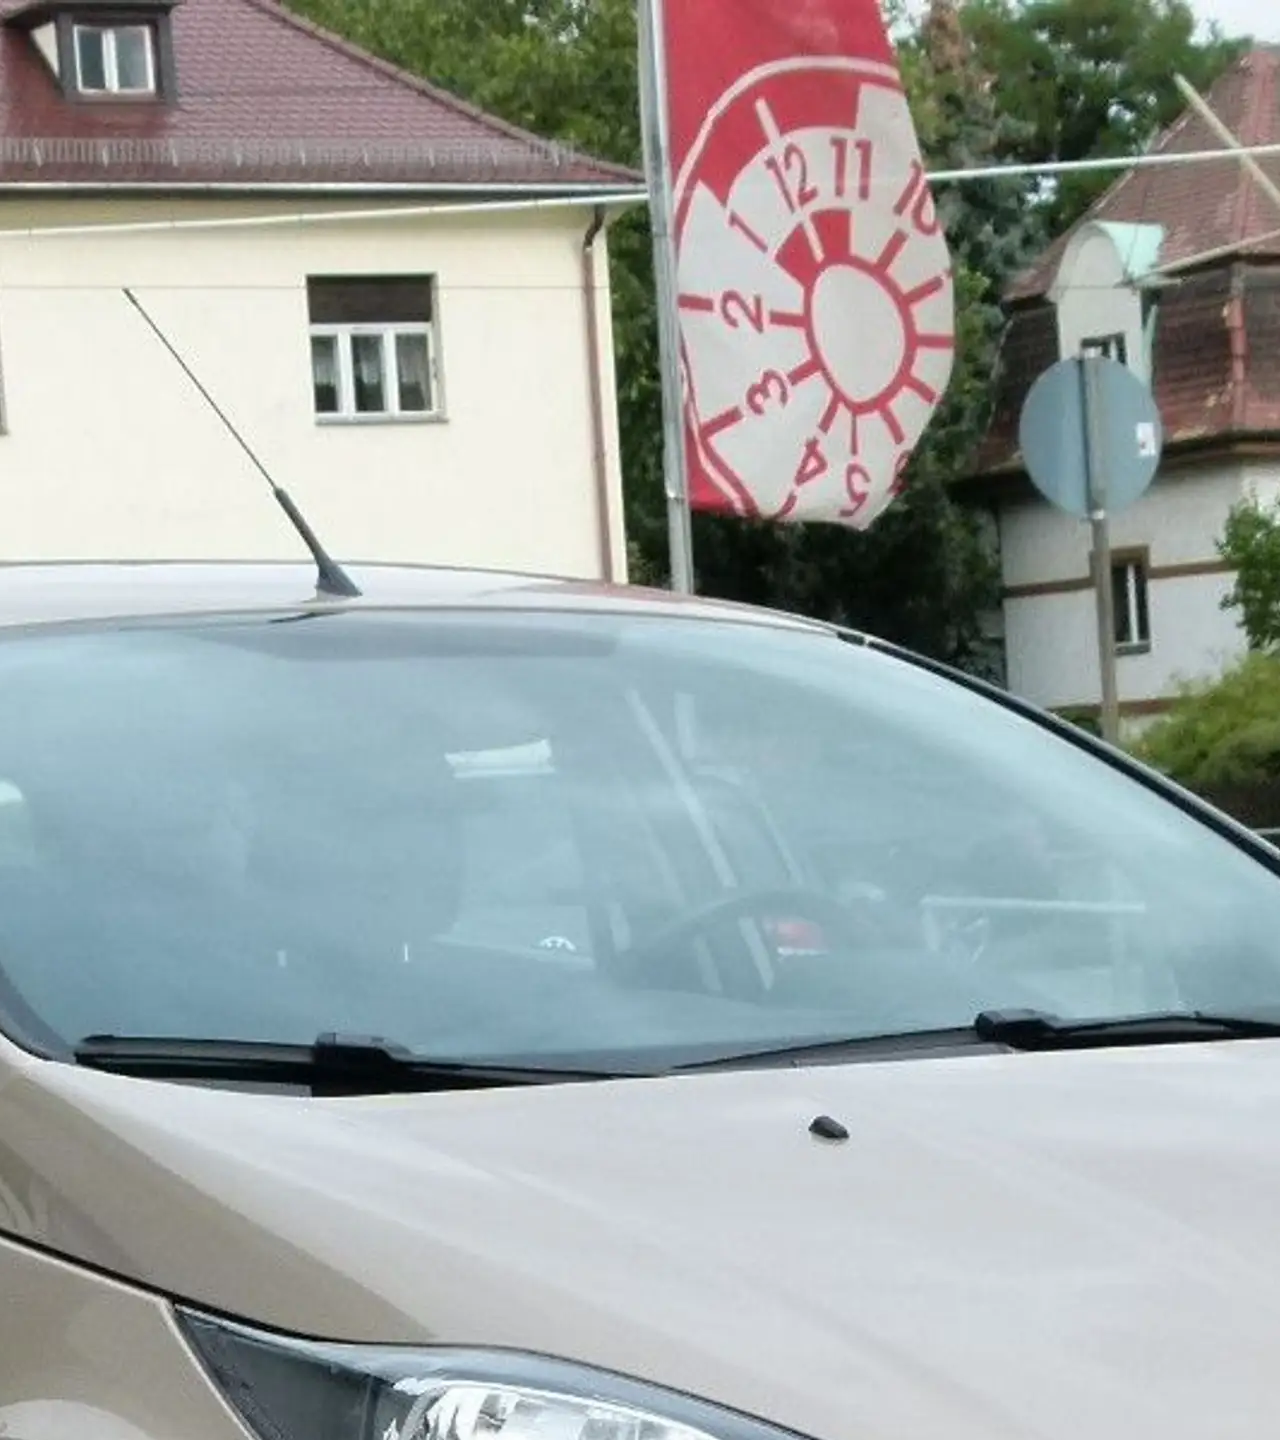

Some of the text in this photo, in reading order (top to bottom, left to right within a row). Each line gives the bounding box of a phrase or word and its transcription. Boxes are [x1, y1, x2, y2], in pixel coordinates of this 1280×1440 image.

[764, 143, 818, 214] 12
[830, 136, 872, 200] 11
[728, 209, 768, 253] 1
[721, 290, 764, 334] 2
[746, 370, 788, 415] 3
[839, 463, 871, 517] 5
